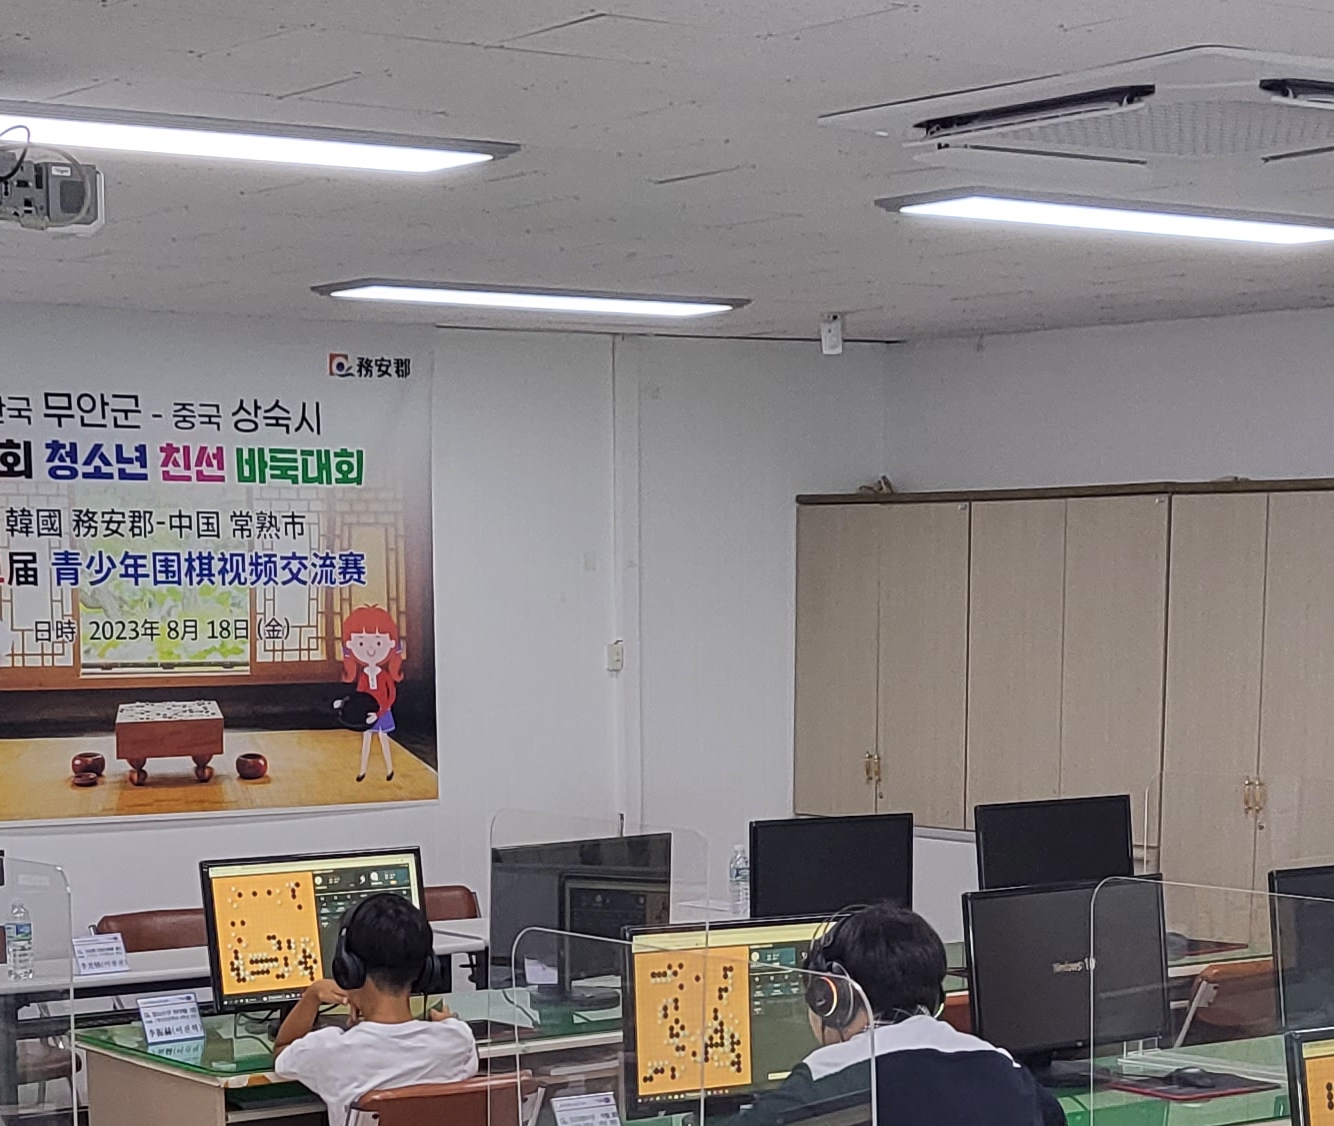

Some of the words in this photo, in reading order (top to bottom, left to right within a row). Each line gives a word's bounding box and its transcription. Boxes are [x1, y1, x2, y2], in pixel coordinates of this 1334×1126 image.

[356, 357, 411, 379] 務安郡
[43, 391, 142, 429] 무안군
[172, 402, 222, 431] 중국
[231, 398, 322, 436] 상숙시
[44, 439, 149, 481] 청소년
[159, 442, 226, 483] 친선
[235, 446, 365, 486] 바둑대회
[5, 506, 63, 538] 韓國
[229, 510, 307, 541] 常熟市
[51, 549, 367, 587] 青少年围棋视频交流赛
[33, 619, 77, 643] 日時
[88, 618, 161, 641] 2023年
[167, 619, 198, 640] 8月
[206, 619, 250, 641] 18日
[256, 617, 291, 641] (金)
